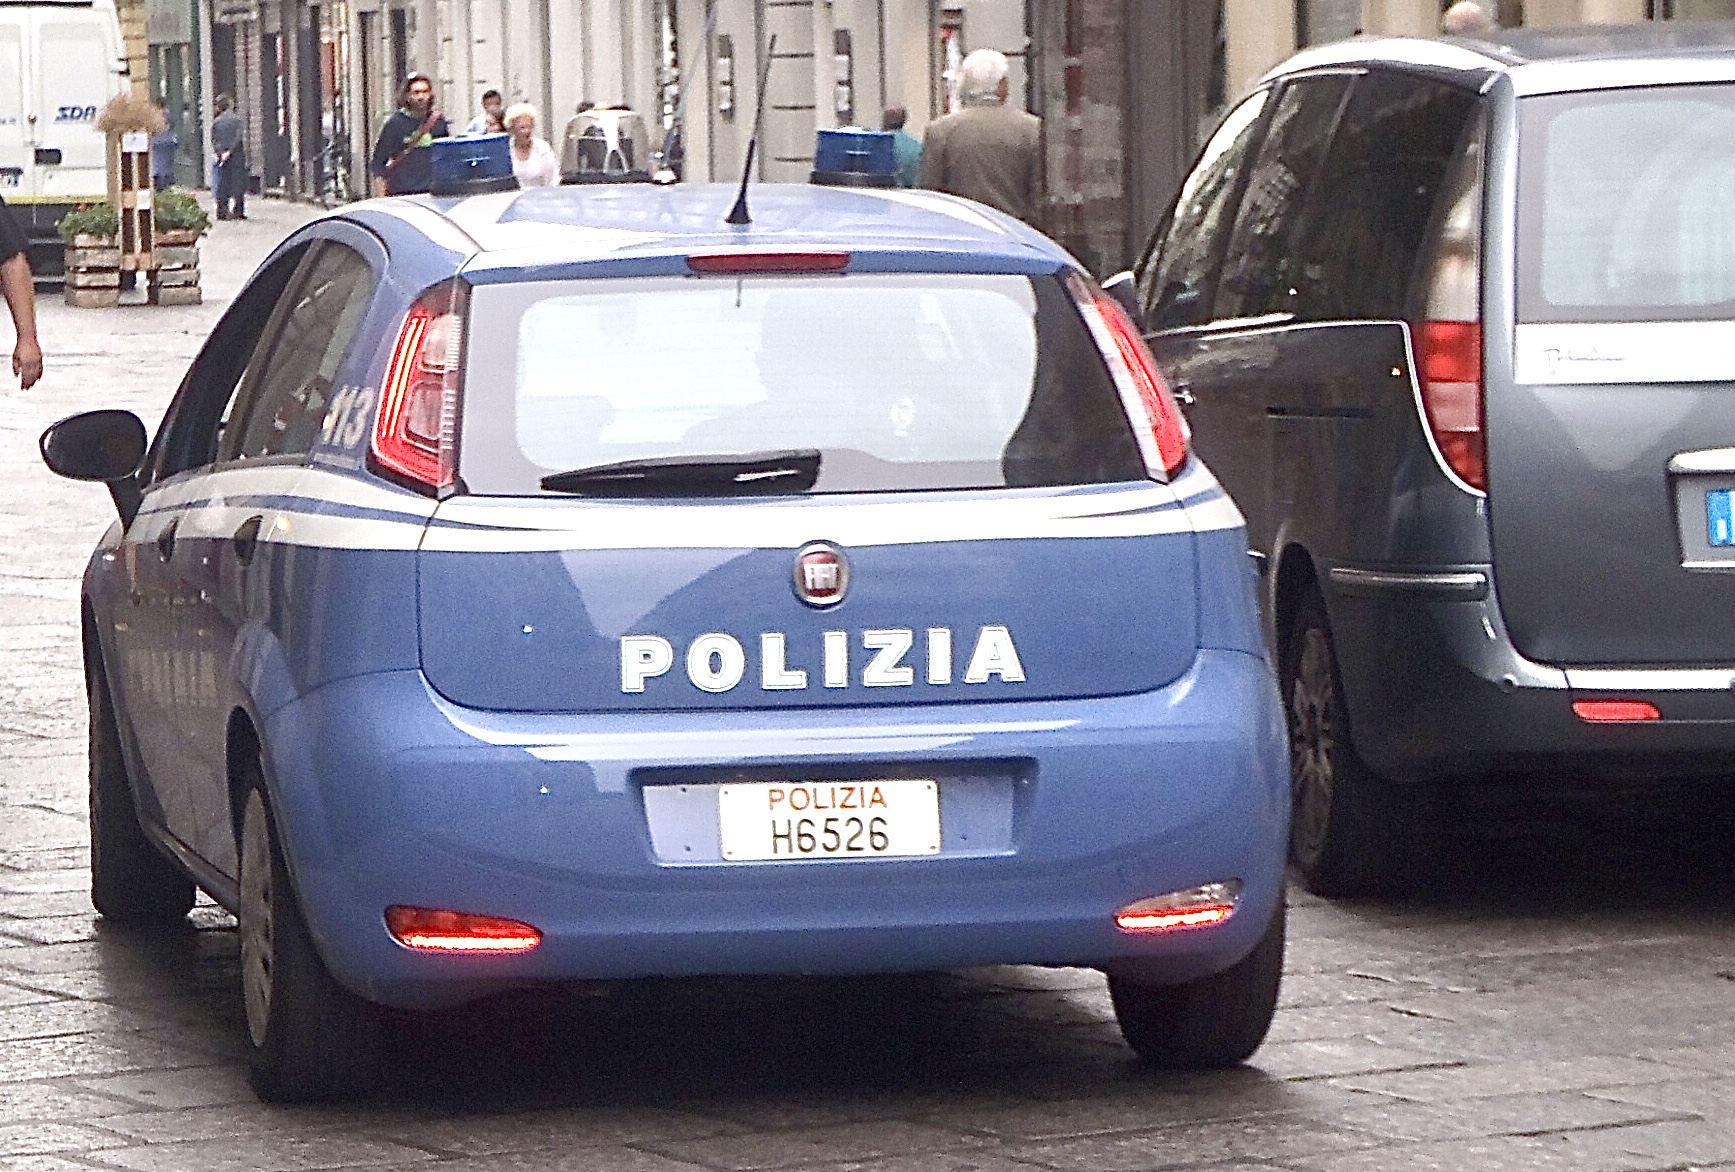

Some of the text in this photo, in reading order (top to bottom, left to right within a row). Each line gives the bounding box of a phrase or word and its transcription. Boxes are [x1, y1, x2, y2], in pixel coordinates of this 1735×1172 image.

[322, 384, 375, 450] 113
[621, 625, 1026, 693] POLIZIA
[768, 786, 888, 811] POLIZIA
[771, 816, 890, 854] H6526
